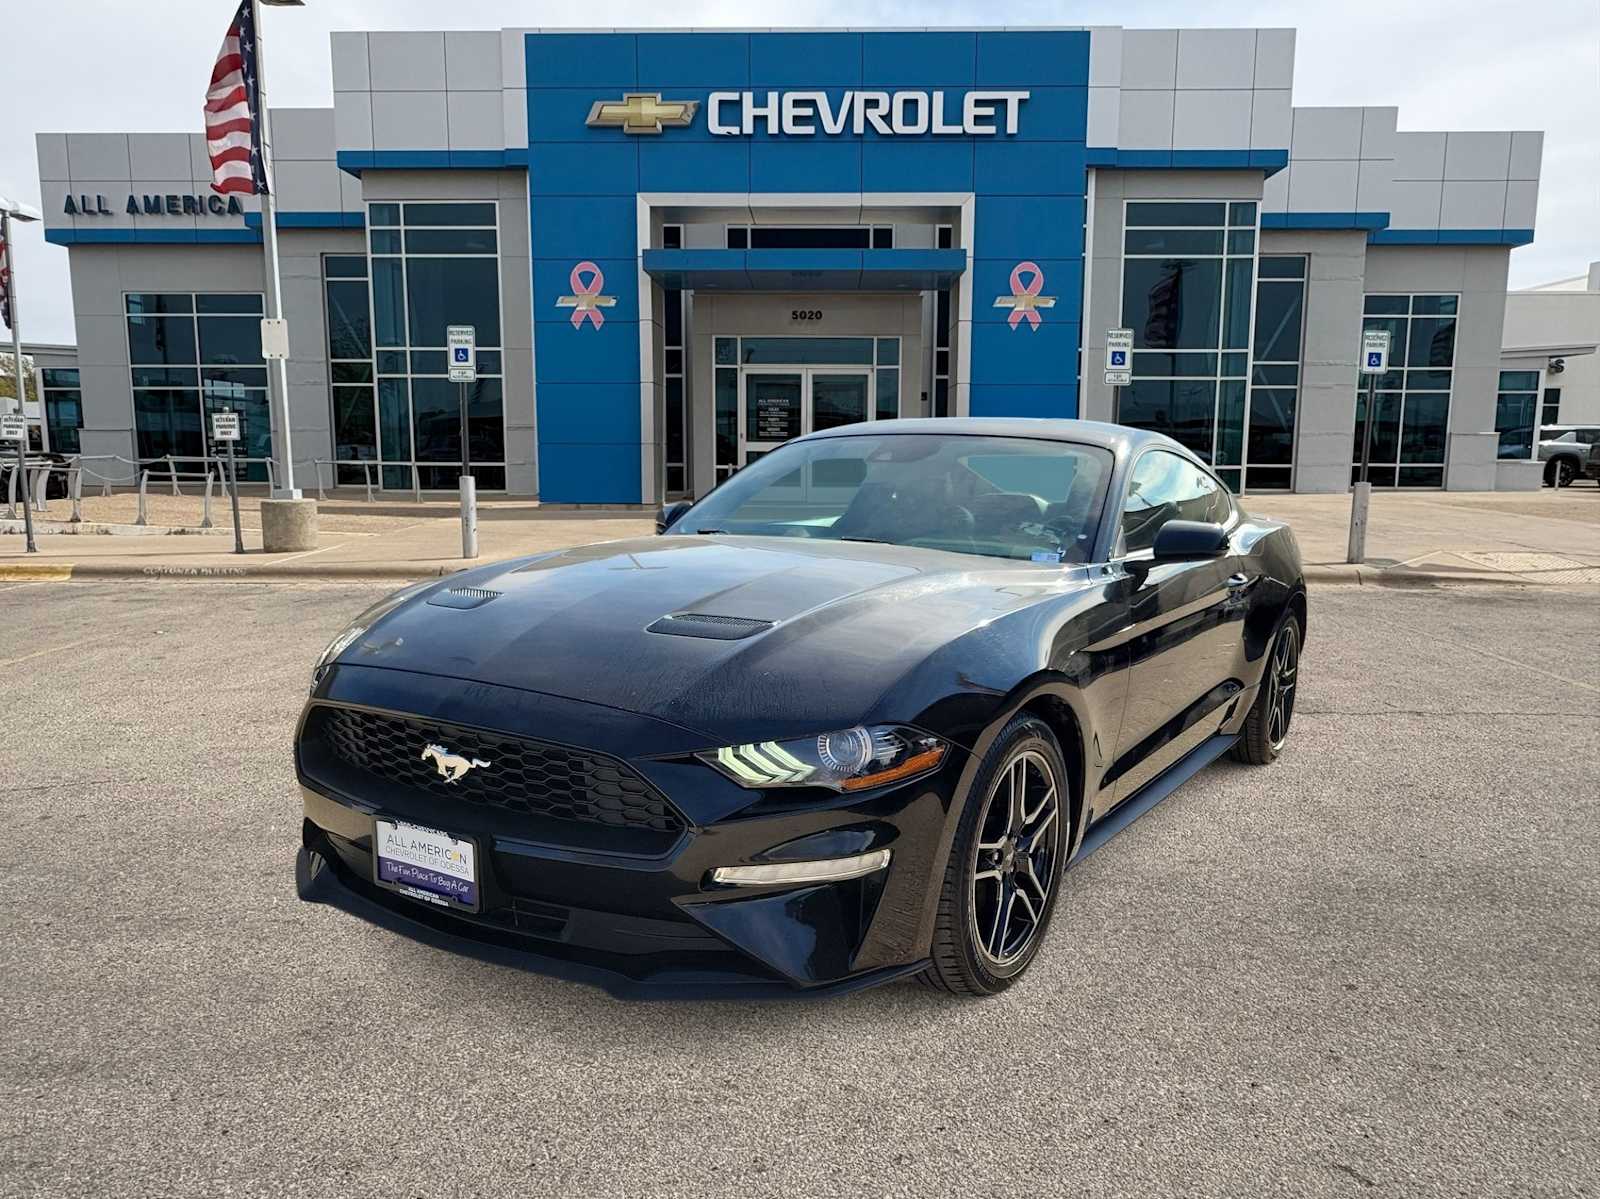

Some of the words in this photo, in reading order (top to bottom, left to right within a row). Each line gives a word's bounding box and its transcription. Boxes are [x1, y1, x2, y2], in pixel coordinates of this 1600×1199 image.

[708, 91, 1030, 135] CHEVROLET
[64, 194, 113, 216] ALL
[126, 194, 243, 217] AMERICA
[791, 310, 823, 320] 5020
[386, 833, 408, 849] ALL
[385, 845, 428, 864] CHEVROLET
[429, 856, 439, 866] OF
[440, 857, 470, 877] ODESSA
[385, 861, 399, 874] The
[399, 865, 412, 877] Fun
[411, 867, 428, 881] Place
[429, 872, 438, 883] To
[438, 875, 451, 891] Buy
[458, 882, 470, 893] Car
